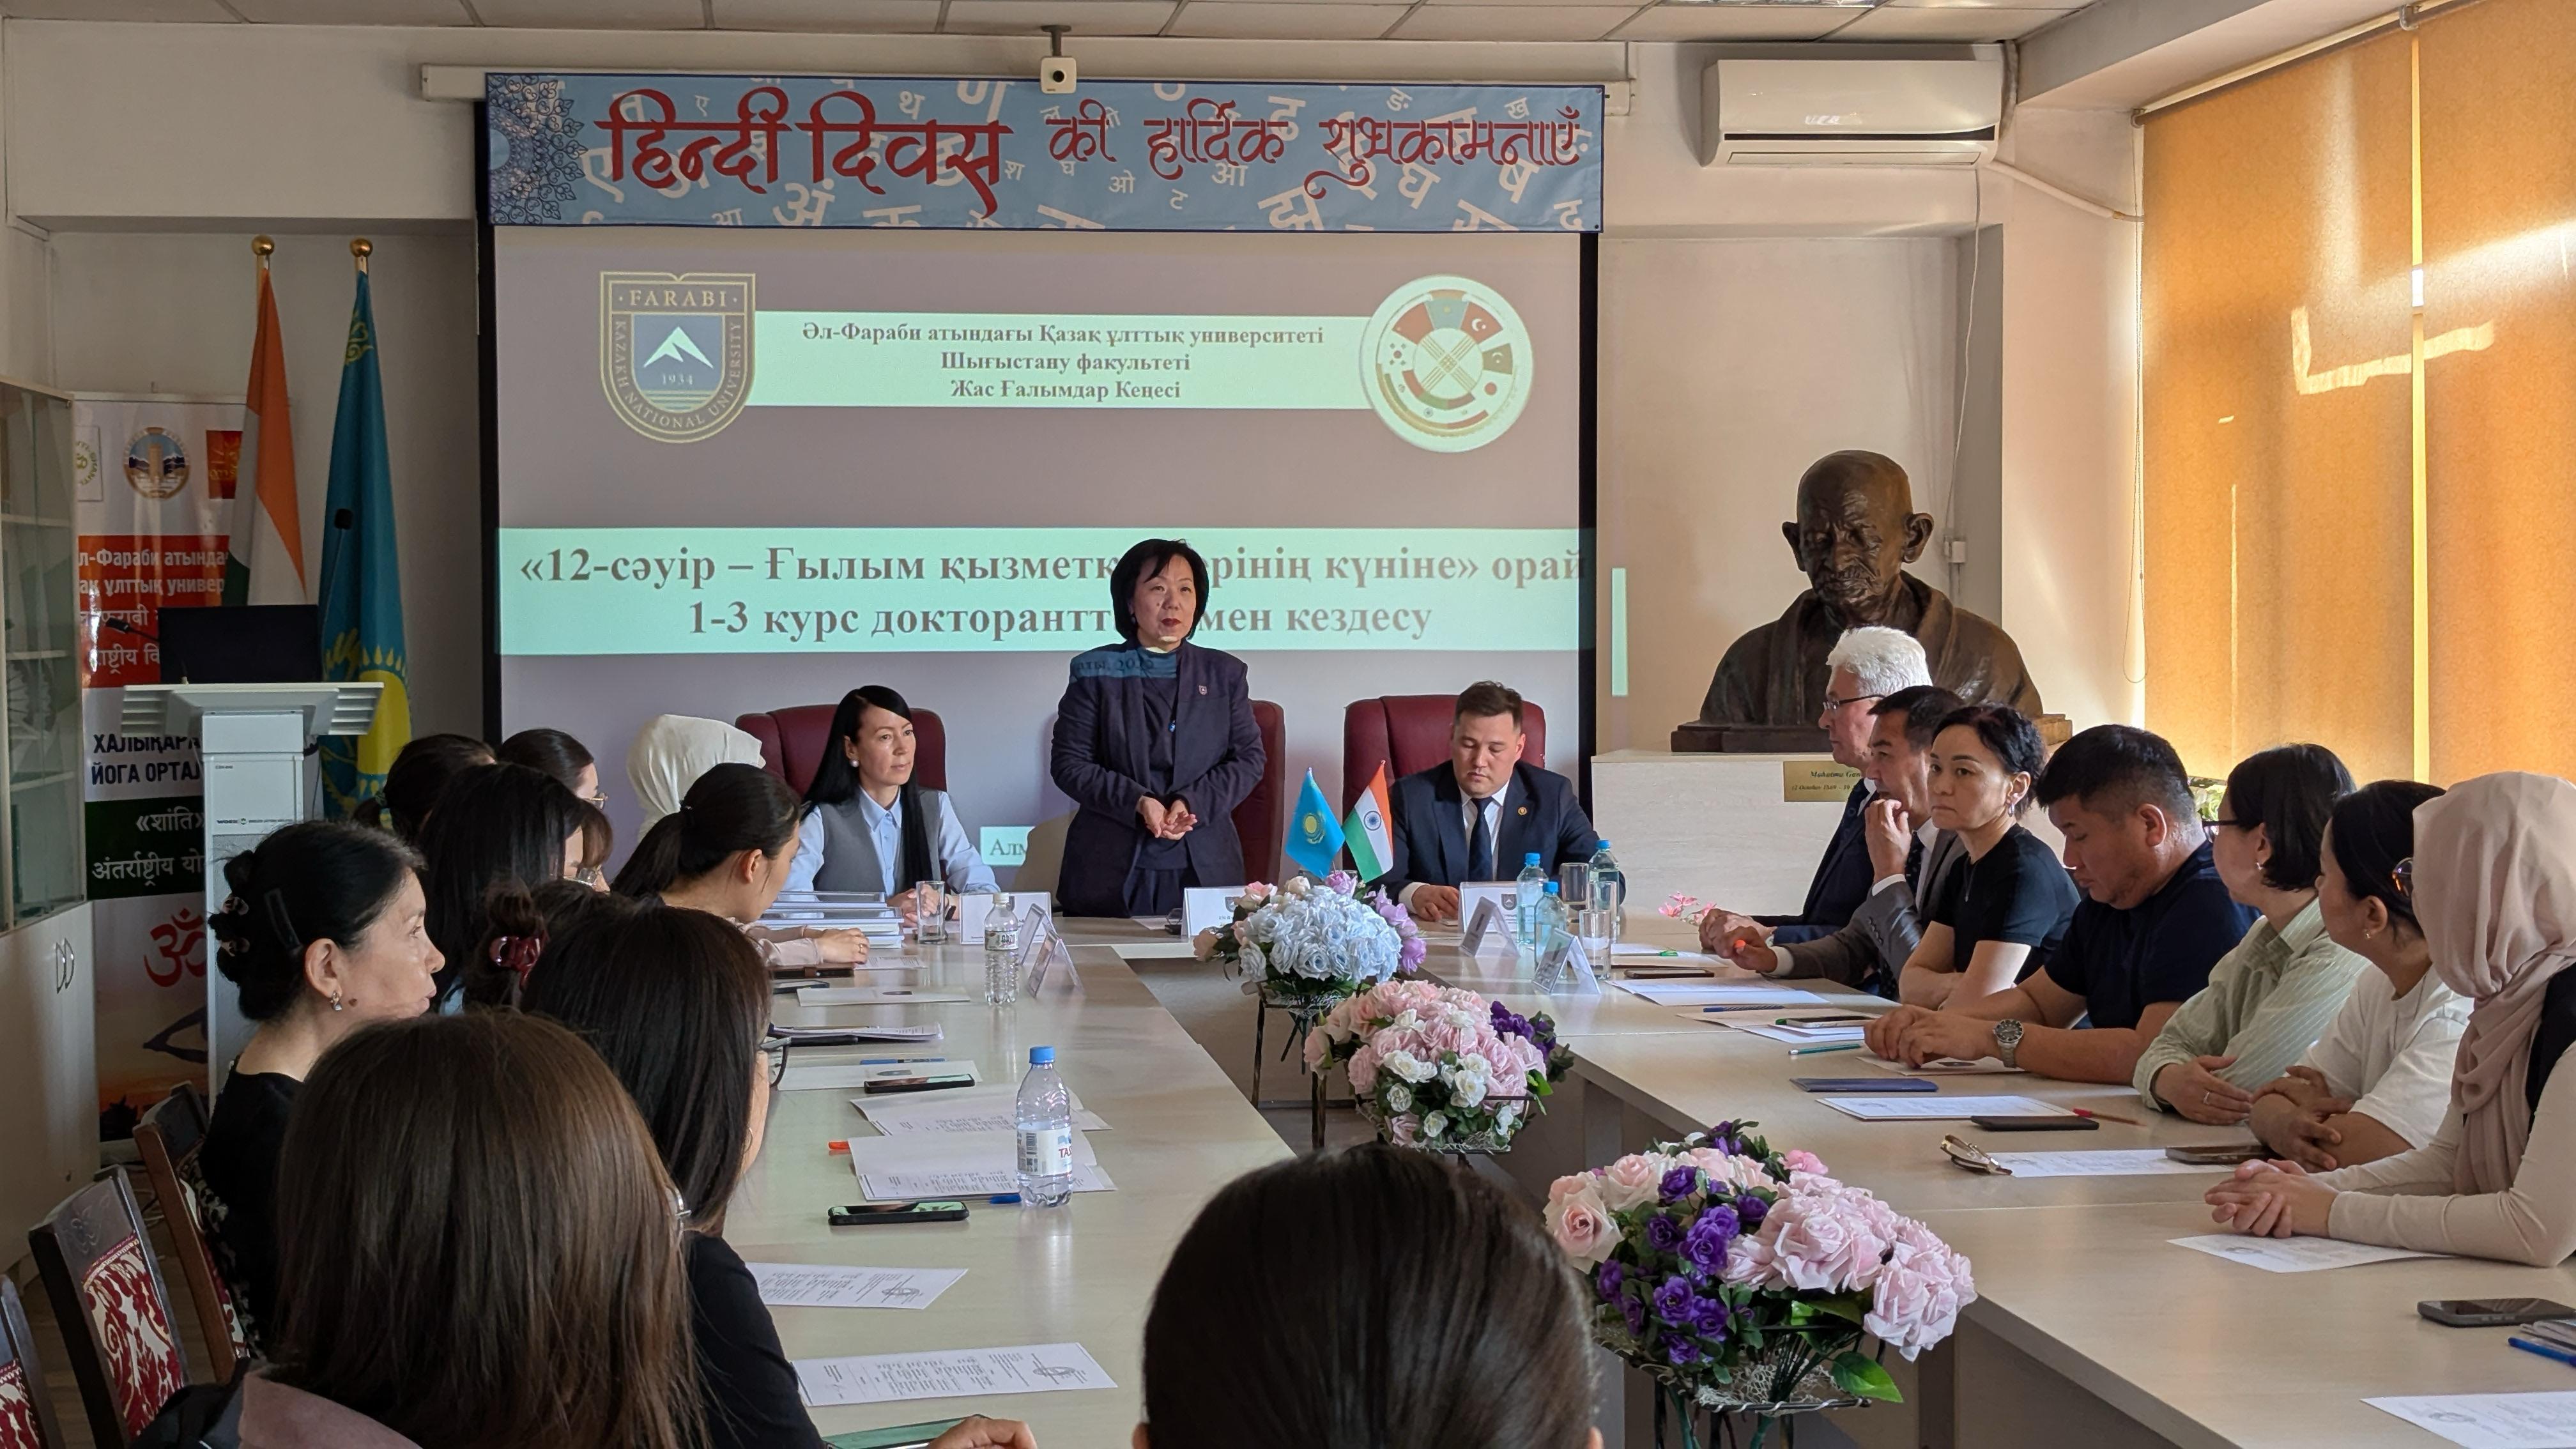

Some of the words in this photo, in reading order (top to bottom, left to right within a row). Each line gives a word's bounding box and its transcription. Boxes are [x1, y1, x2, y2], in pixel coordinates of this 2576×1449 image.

[594, 86, 792, 194] हिन्दी
[795, 91, 1014, 219] दिवस
[1045, 98, 1117, 162] की
[1144, 98, 1289, 180] हार्दिक
[1304, 105, 1580, 200] शुभकामनाएँ
[630, 290, 726, 307] FARABI
[802, 322, 921, 344] Әл-Фараби
[928, 325, 1032, 342] атындағы
[1038, 324, 1101, 345] Қазақ
[1107, 328, 1184, 347] ұлттық
[1189, 326, 1324, 348] университеті
[941, 351, 1070, 374] Шығыстану
[1077, 353, 1190, 374] факультеті
[615, 320, 629, 388] KAZAKH
[625, 392, 706, 429] NATIONAL
[708, 322, 741, 417] UNIVERSITY
[951, 379, 994, 397] Жас
[1000, 379, 1108, 402] Ғалымдар
[1115, 381, 1180, 400] Кеңесі
[79, 548, 159, 569] л-Фараби
[520, 547, 716, 589] «12-сәуір
[765, 547, 924, 580] Ғылым
[940, 546, 1311, 588] қызметкрінің
[1325, 547, 1479, 588] күніне»
[167, 578, 225, 596] универ
[690, 601, 749, 633] 1-3
[763, 608, 859, 643] курс
[1286, 608, 1432, 640] кездесу
[93, 734, 201, 754] ХАЛЫҚАРА
[91, 762, 141, 786] ЙОГА
